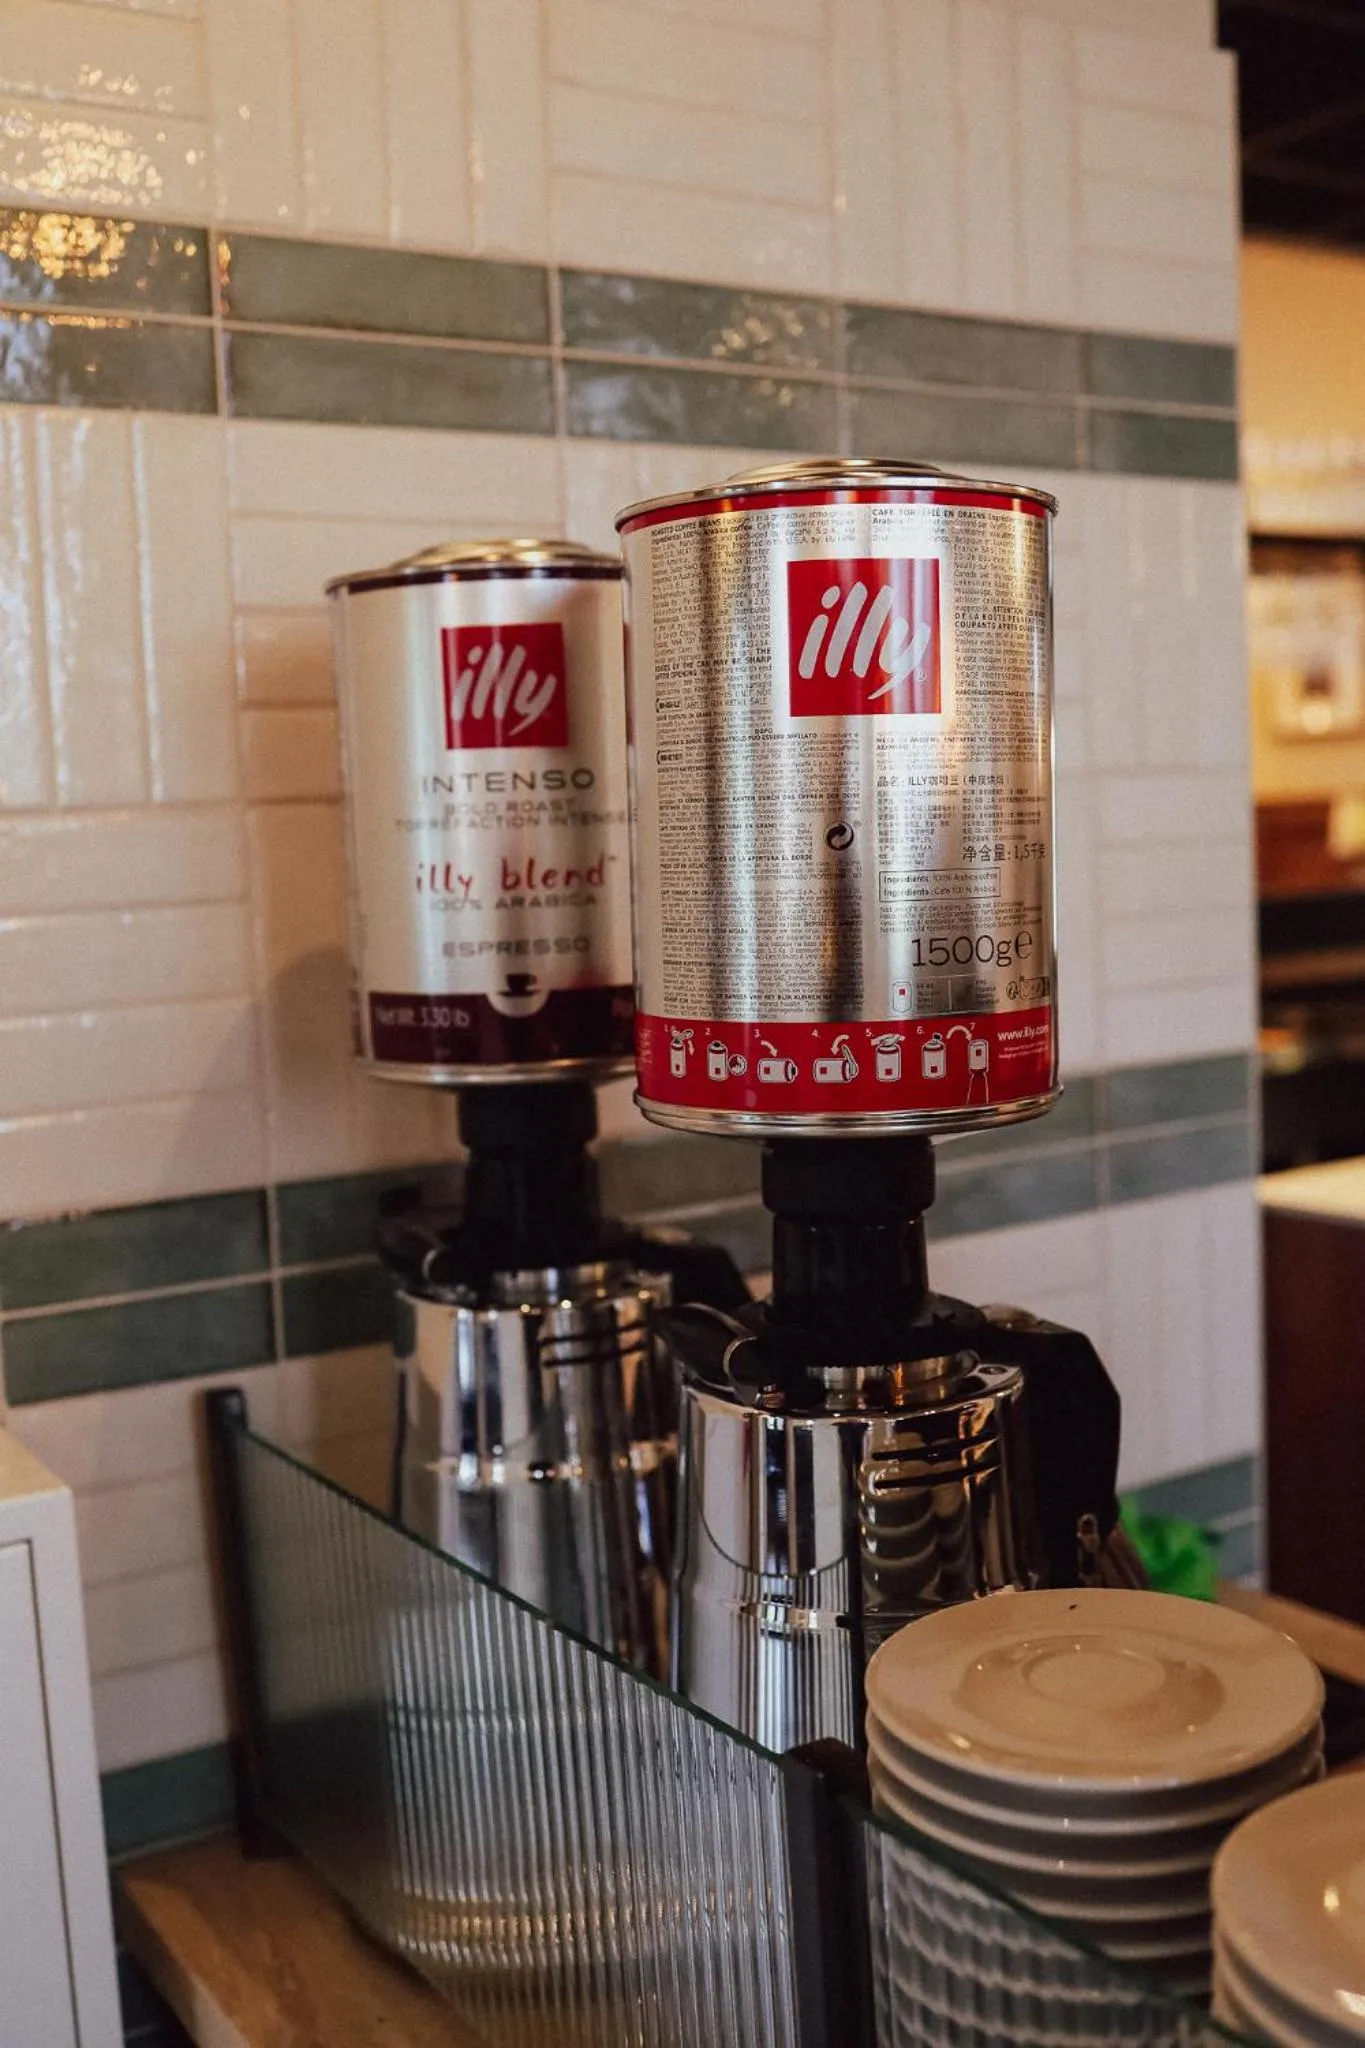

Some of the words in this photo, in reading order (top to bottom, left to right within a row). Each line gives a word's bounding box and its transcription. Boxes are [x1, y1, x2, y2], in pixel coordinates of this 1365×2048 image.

[798, 581, 931, 700] illy
[452, 641, 557, 736] illy
[422, 767, 596, 794] INTENSO
[416, 862, 473, 901] illy
[442, 936, 591, 958] ESPRESSO
